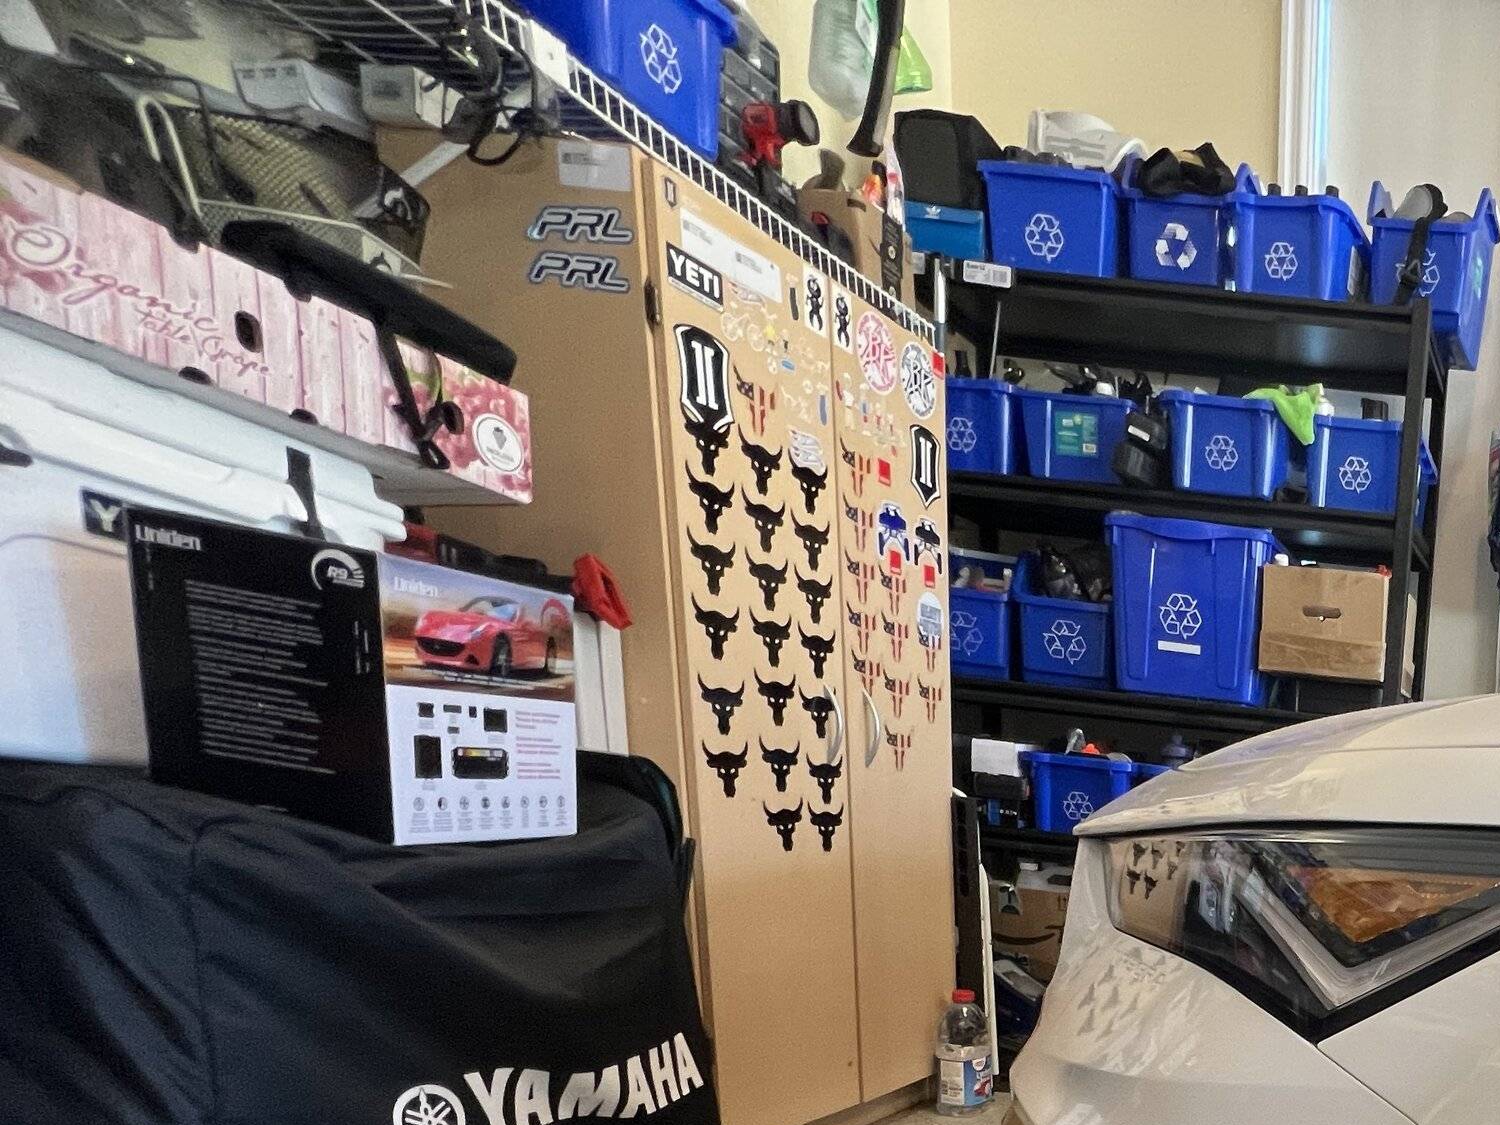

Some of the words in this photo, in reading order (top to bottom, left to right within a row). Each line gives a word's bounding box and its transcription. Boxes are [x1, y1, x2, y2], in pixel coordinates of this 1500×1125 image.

[529, 207, 633, 243] PRL
[9, 223, 219, 332] Organic
[530, 252, 630, 292] PRL
[669, 249, 721, 299] YETI
